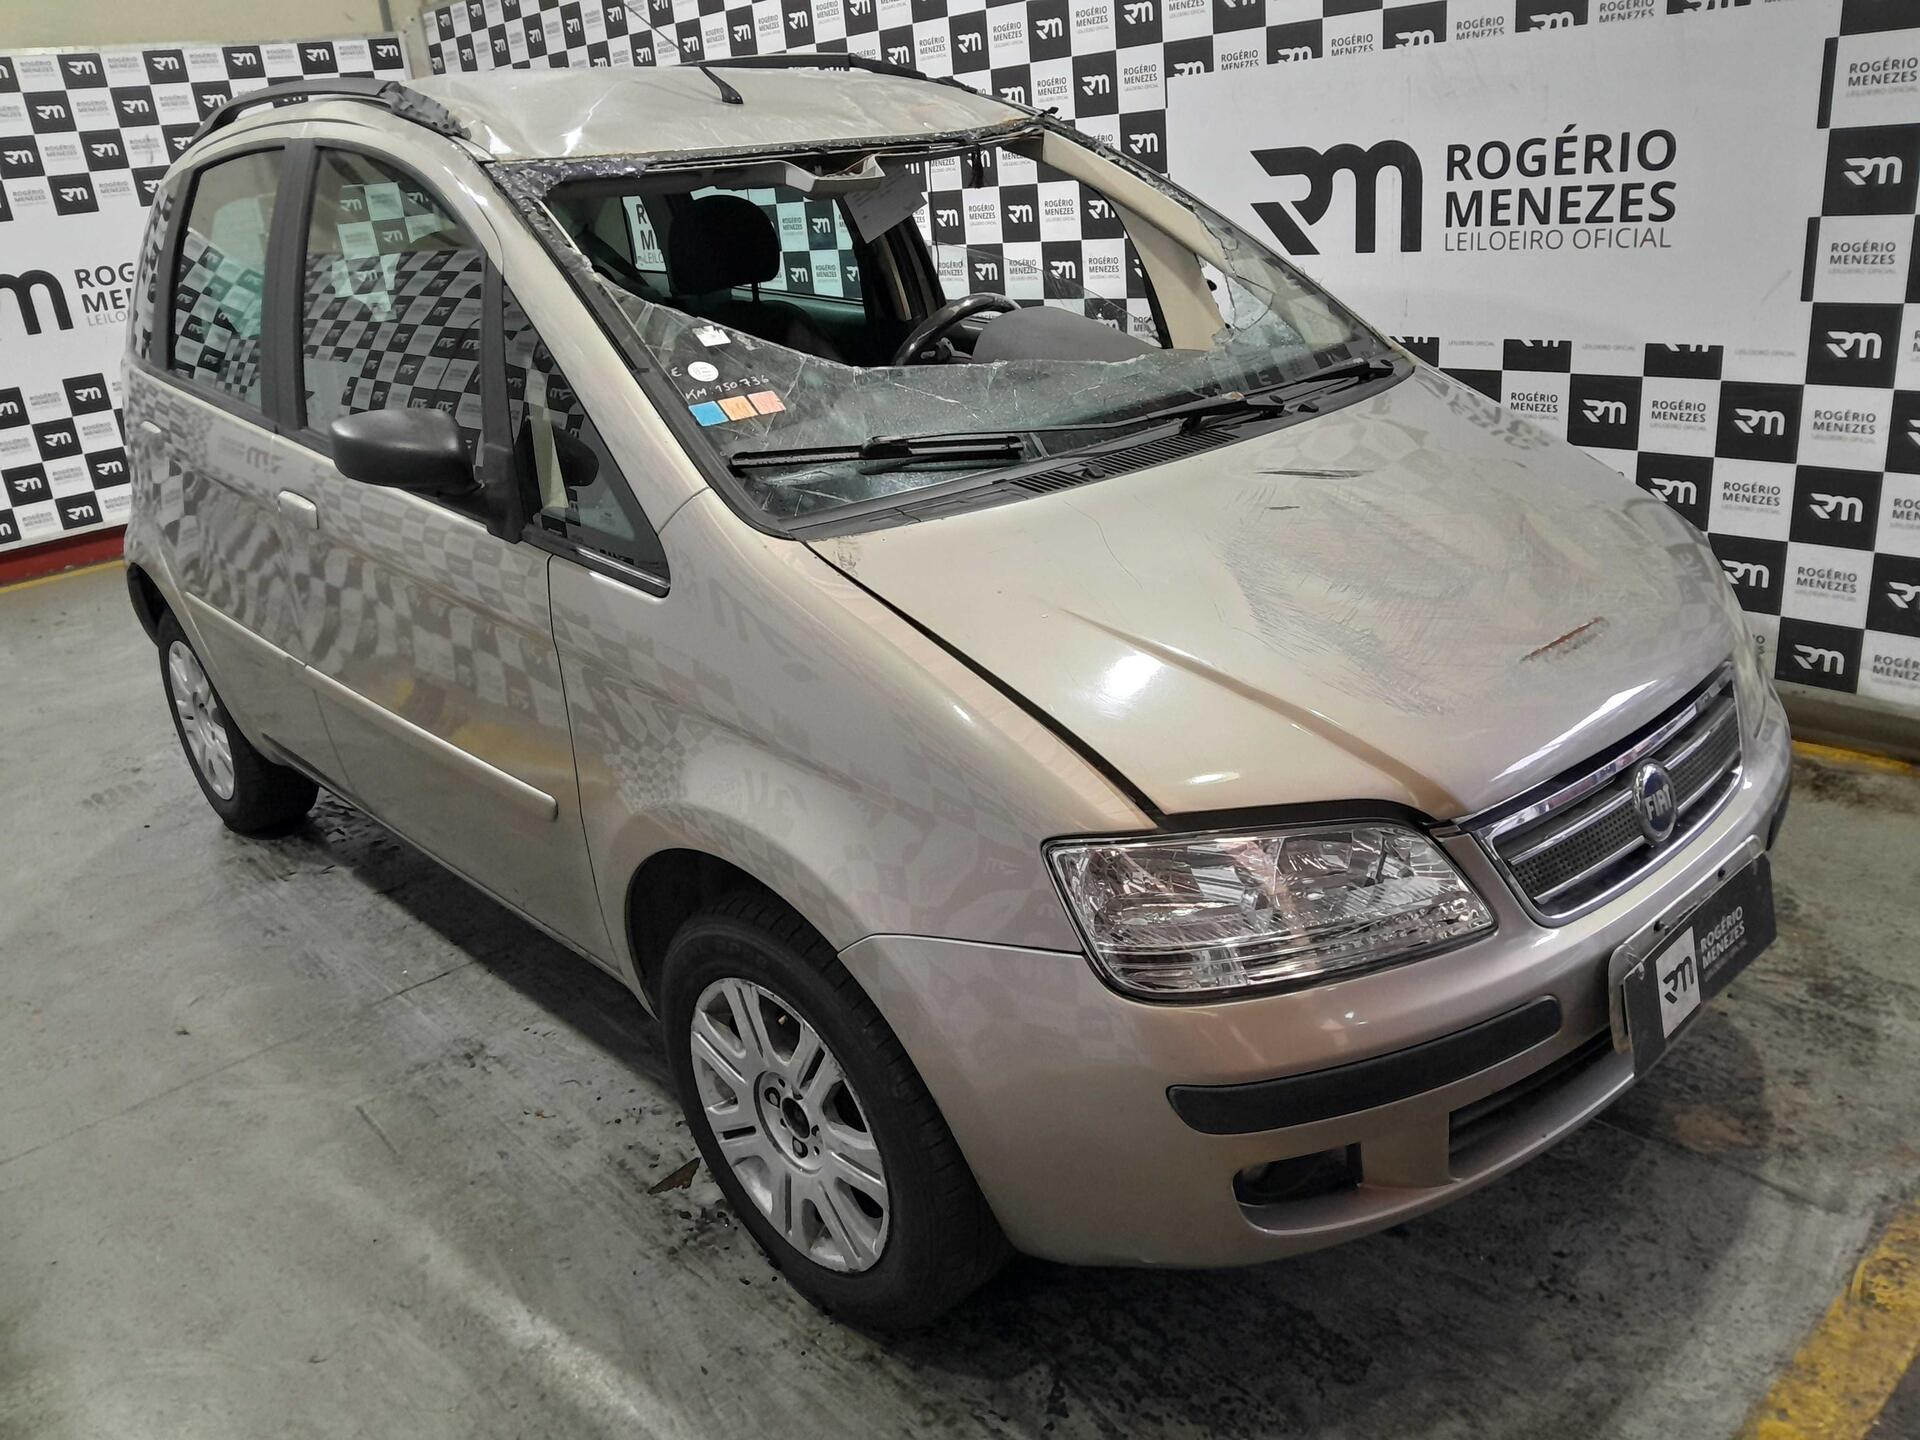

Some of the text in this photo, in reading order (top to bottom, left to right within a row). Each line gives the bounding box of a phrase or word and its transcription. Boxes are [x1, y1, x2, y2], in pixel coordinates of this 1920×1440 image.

[788, 11, 808, 29] RM
[1076, 6, 1108, 19] ROGÉRIO
[1124, 0, 1153, 24] RM
[993, 21, 1021, 34] ROGÉRIO
[1036, 18, 1062, 40] RM
[1076, 14, 1108, 28] MENEZES
[1456, 16, 1504, 31] ROGÉRIO
[733, 24, 751, 41] RM
[994, 30, 1022, 42] MENEZES
[1332, 34, 1373, 47] ROGÉRIO
[682, 36, 699, 53] RM
[919, 36, 944, 46] ROGÉRIO
[958, 32, 982, 53] RM
[920, 44, 946, 55] MENEZES
[1221, 49, 1258, 62] ROGÉRIO
[1124, 64, 1157, 76] ROGÉRIO
[1850, 57, 1918, 73] ROGÉRIO
[1038, 76, 1067, 88] ROGÉRIO
[1082, 74, 1110, 96] RM
[1124, 73, 1158, 85] MENEZES
[1848, 71, 1917, 86] MENEZES
[1038, 84, 1068, 96] MENEZES
[1129, 133, 1158, 154] RM
[1447, 124, 1677, 181] ROGÉRIO
[1843, 156, 1903, 185] RM
[1045, 198, 1073, 208] ROGÉRIO
[1250, 140, 1423, 255] RM
[1445, 182, 1677, 227] MENEZES
[969, 203, 994, 212] ROGÉRIO
[969, 211, 996, 220] MENEZES
[1008, 204, 1033, 224] RM
[1045, 207, 1074, 215] MENEZES
[812, 218, 830, 234] RM
[936, 210, 959, 227] RM
[1445, 227, 1671, 251] LEILOEIRO OFICIAL
[1830, 240, 1896, 253] ROGÉRIO
[1089, 256, 1118, 264] ROGÉRIO
[1829, 254, 1896, 266] MENEZES
[790, 267, 808, 283] RM
[974, 263, 998, 281] RM
[1050, 261, 1076, 280] RM
[1089, 264, 1119, 273] MENEZES
[1826, 331, 1882, 359] RM
[1511, 392, 1558, 402] ROGÉRIO
[1652, 399, 1706, 411] ROGÉRIO
[1511, 402, 1558, 413] MENEZES
[1583, 400, 1627, 424] RM
[1651, 411, 1706, 422] MENEZES
[1734, 408, 1785, 435] RM
[1814, 410, 1876, 423] ROGÉRIO
[1813, 421, 1876, 435] MENEZES
[1651, 478, 1696, 504] RM
[1723, 481, 1780, 495] ROGÉRIO
[1722, 492, 1780, 506] MENEZES
[1809, 492, 1863, 522] RM
[1721, 560, 1770, 588] RM
[1798, 566, 1857, 582] ROGÉRIO
[1796, 577, 1857, 593] MENEZES
[1793, 644, 1844, 674] RM
[1874, 655, 1920, 669] ROGÉR
[1873, 665, 1920, 681] MENEZ
[1645, 784, 1673, 820] FIAT
[1700, 906, 1743, 952] ROGÉRIO
[1702, 922, 1745, 970] MENEZES
[1663, 955, 1694, 1004] RM
